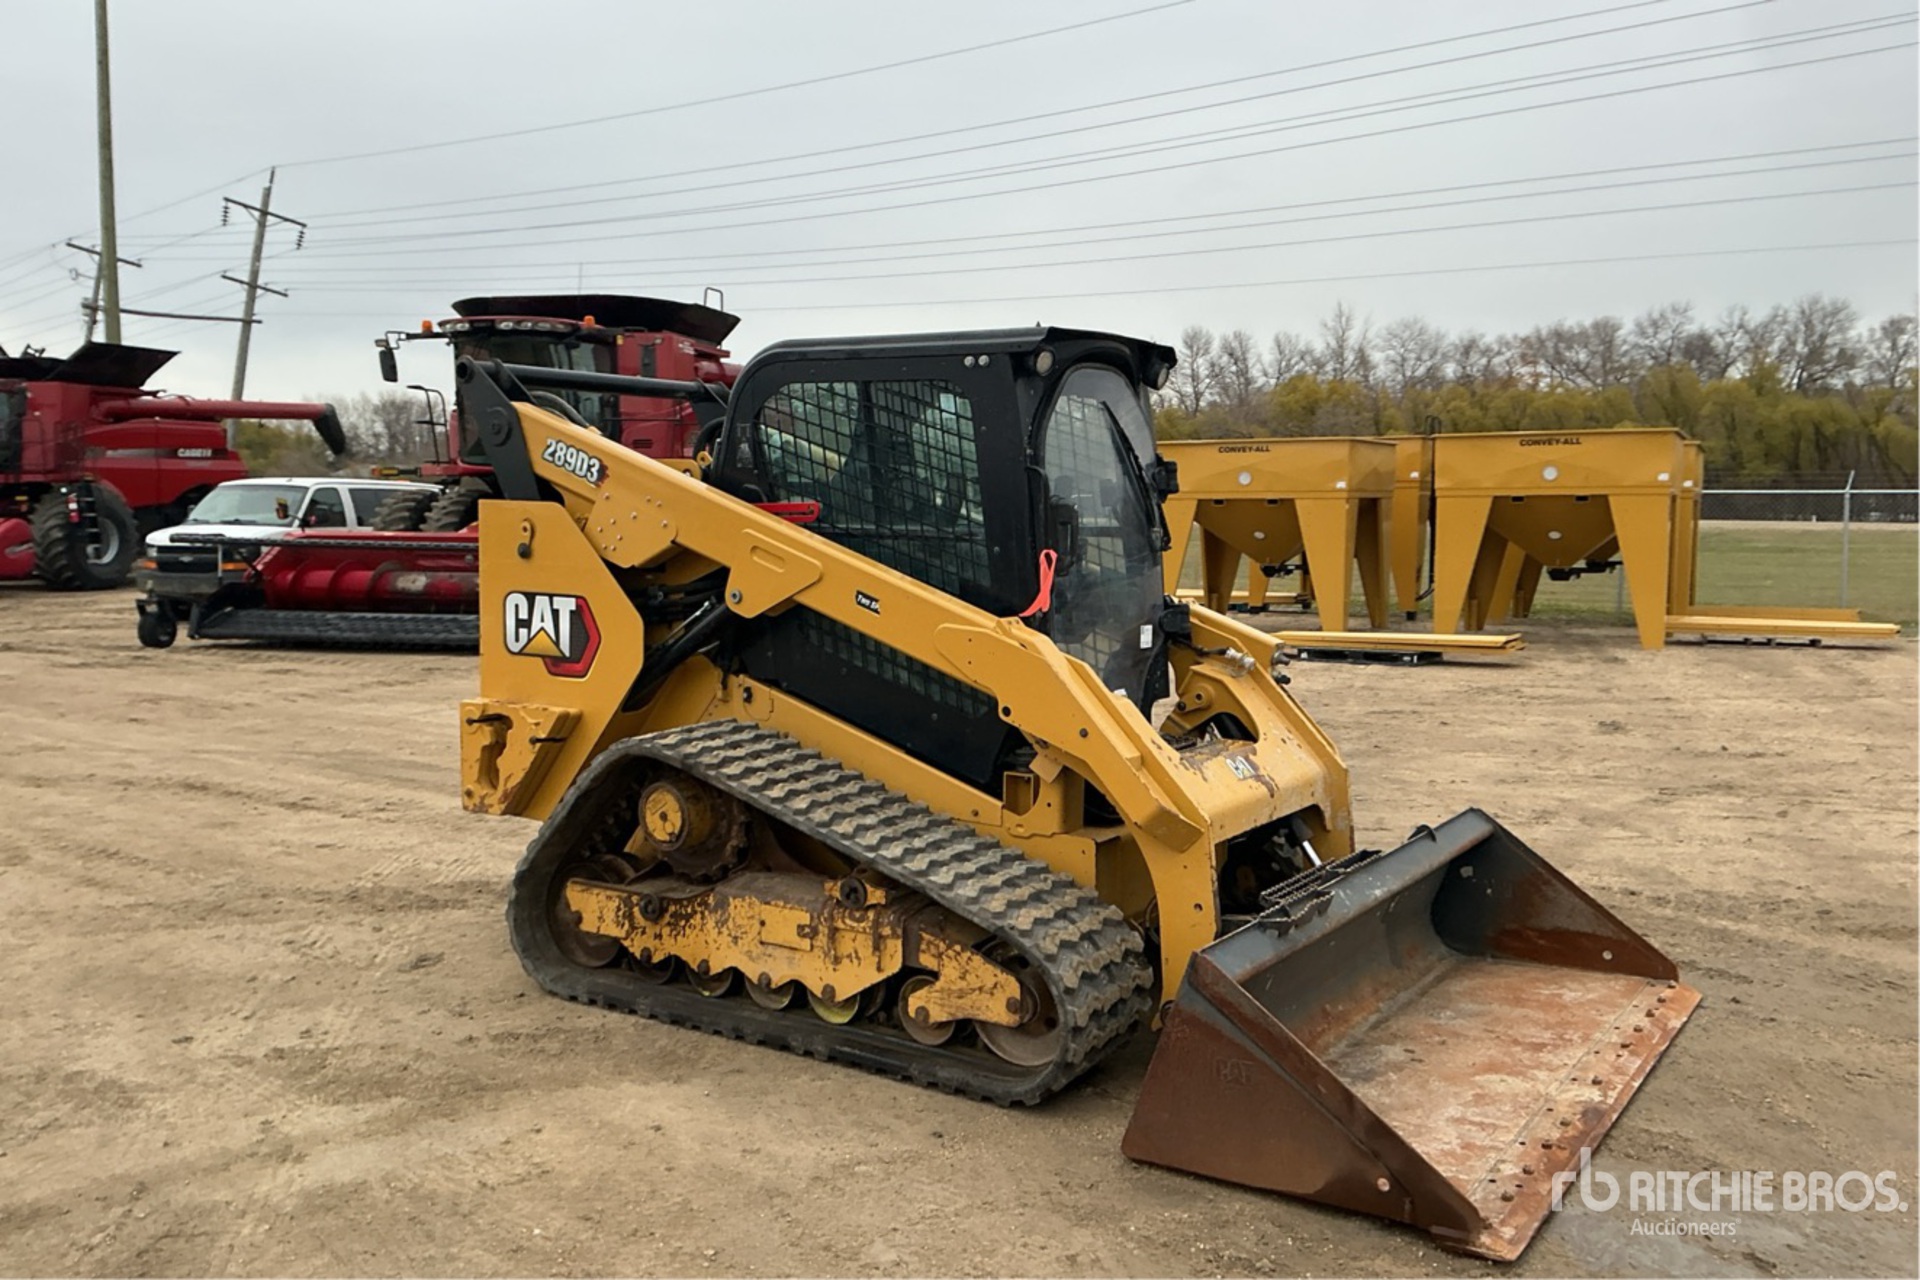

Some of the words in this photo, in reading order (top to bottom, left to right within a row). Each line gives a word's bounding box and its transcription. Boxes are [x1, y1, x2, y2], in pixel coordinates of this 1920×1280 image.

[1218, 445, 1271, 454] CONVEY-ALL
[1518, 437, 1582, 447] CONVEY-ALL
[543, 438, 600, 482] 289D3
[505, 592, 577, 658] CAT
